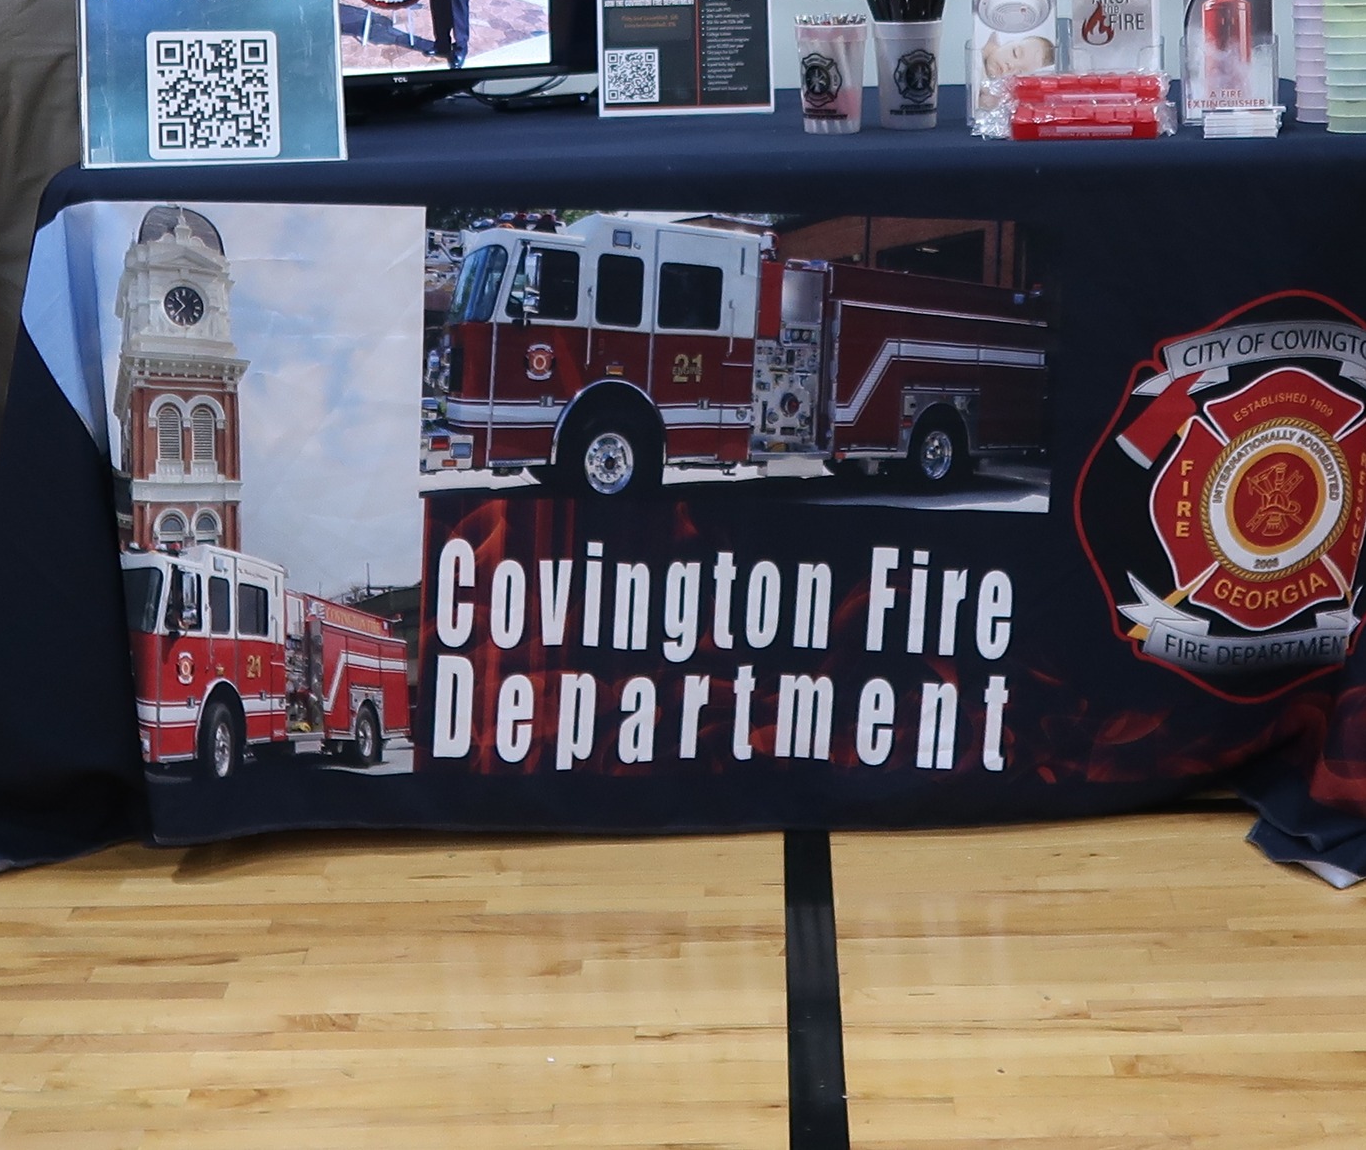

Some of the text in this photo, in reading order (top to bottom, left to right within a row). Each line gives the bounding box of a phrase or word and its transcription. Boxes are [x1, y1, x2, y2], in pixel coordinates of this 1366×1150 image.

[1103, 4, 1120, 14] the
[1108, 13, 1145, 30] FIRE
[1188, 99, 1266, 109] EXTINGUISHER
[1221, 90, 1242, 98] FIRE
[1183, 337, 1232, 367] CITY
[1237, 333, 1266, 355] OF
[672, 367, 702, 375] ENGINE
[673, 353, 702, 383] 21
[1232, 392, 1334, 423] ESTABLISHED 1909
[1212, 430, 1340, 504] INTERNATIONALLY ACCREDITED
[1175, 460, 1195, 539] FIRE
[436, 538, 1013, 662] Covington Fire
[1213, 572, 1329, 611] GEORGIA
[1165, 634, 1210, 665] FIRE
[246, 655, 262, 678] 21
[434, 655, 1009, 771] Department
